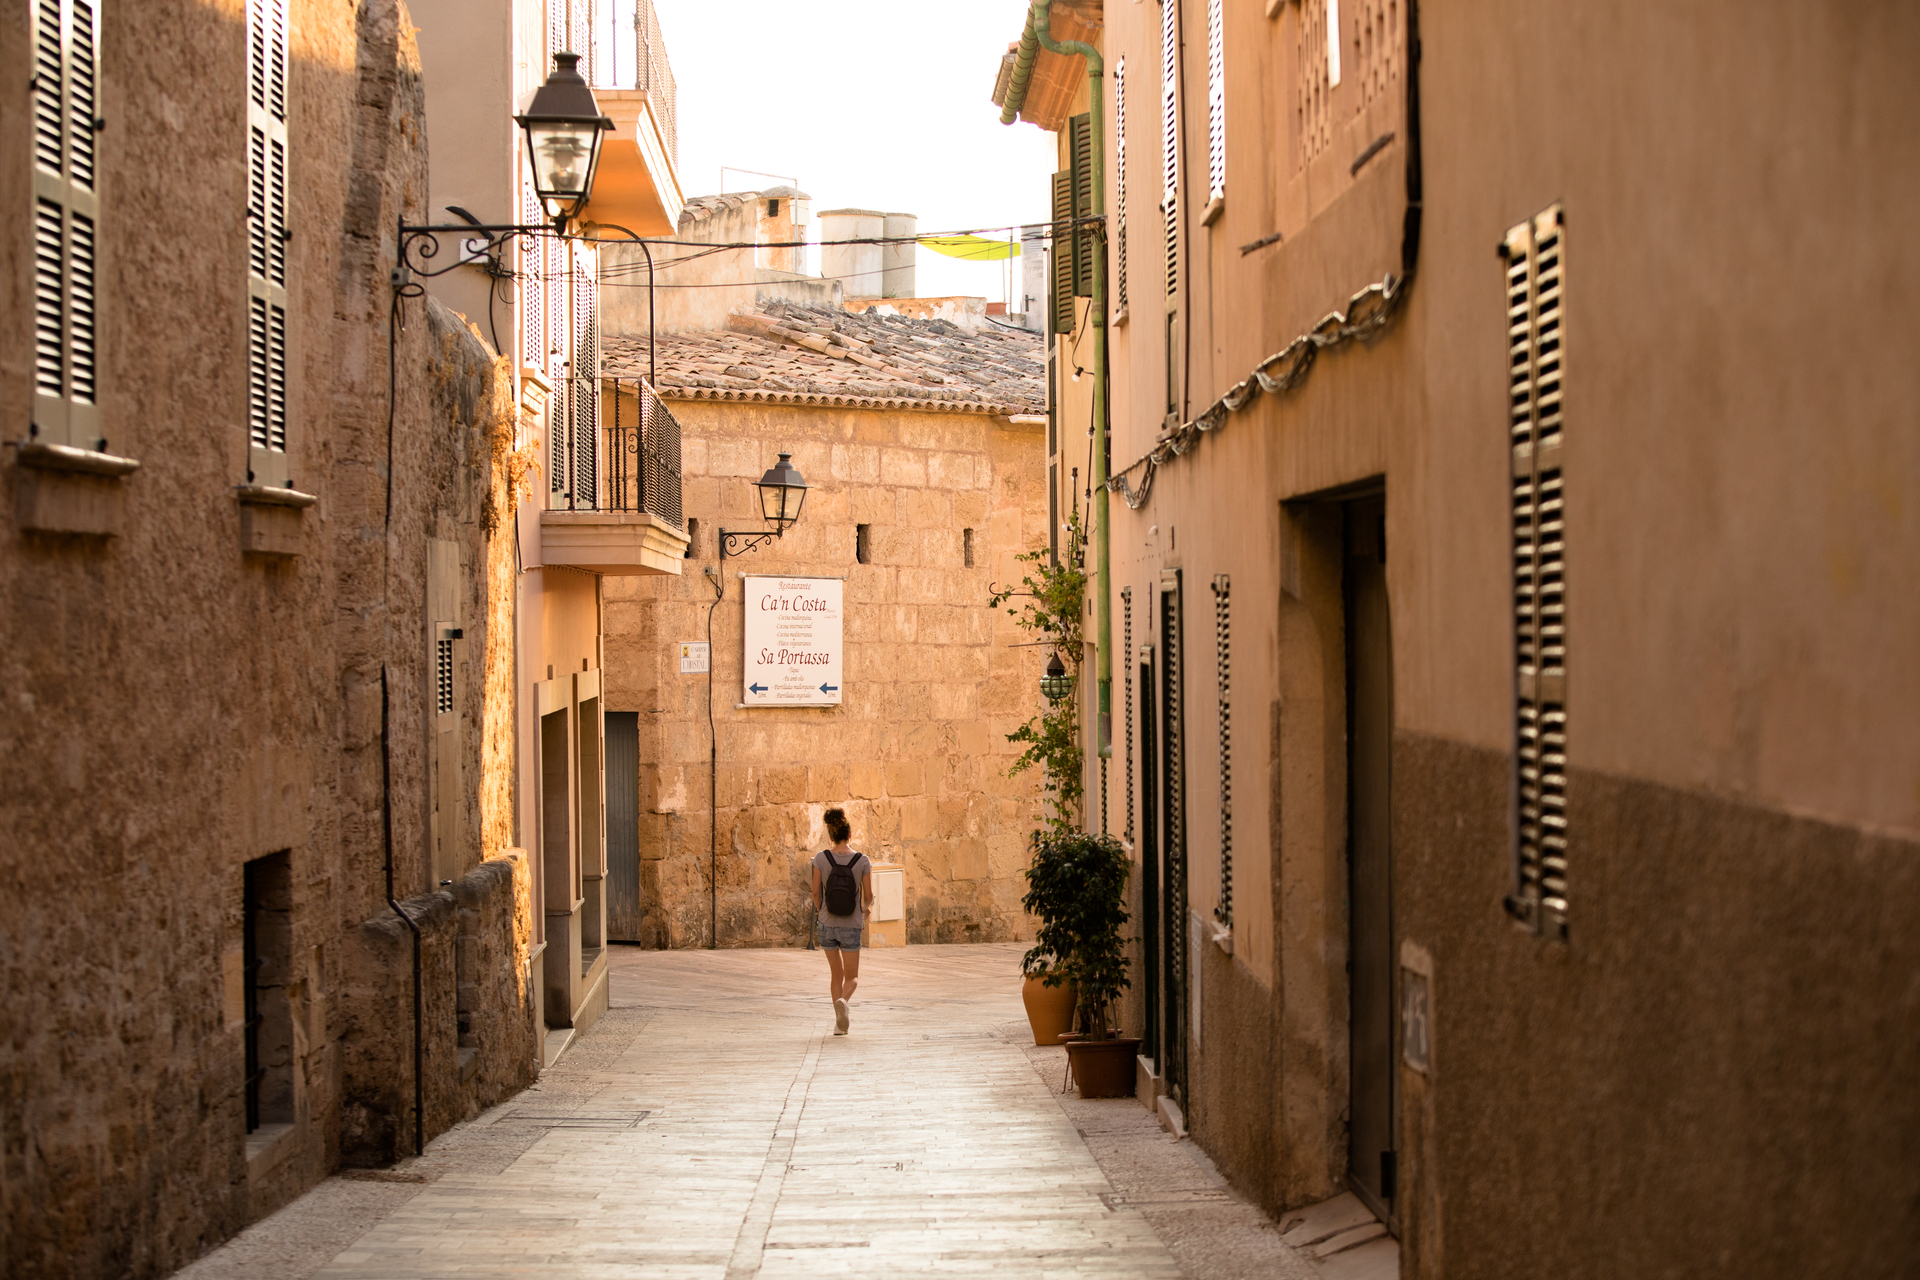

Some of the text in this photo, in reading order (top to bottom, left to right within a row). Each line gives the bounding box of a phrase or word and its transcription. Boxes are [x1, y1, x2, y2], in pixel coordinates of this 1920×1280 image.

[778, 581, 812, 591] Restaurante
[761, 594, 827, 612] Ca'n Costa
[757, 647, 831, 665] Sa Portassa
